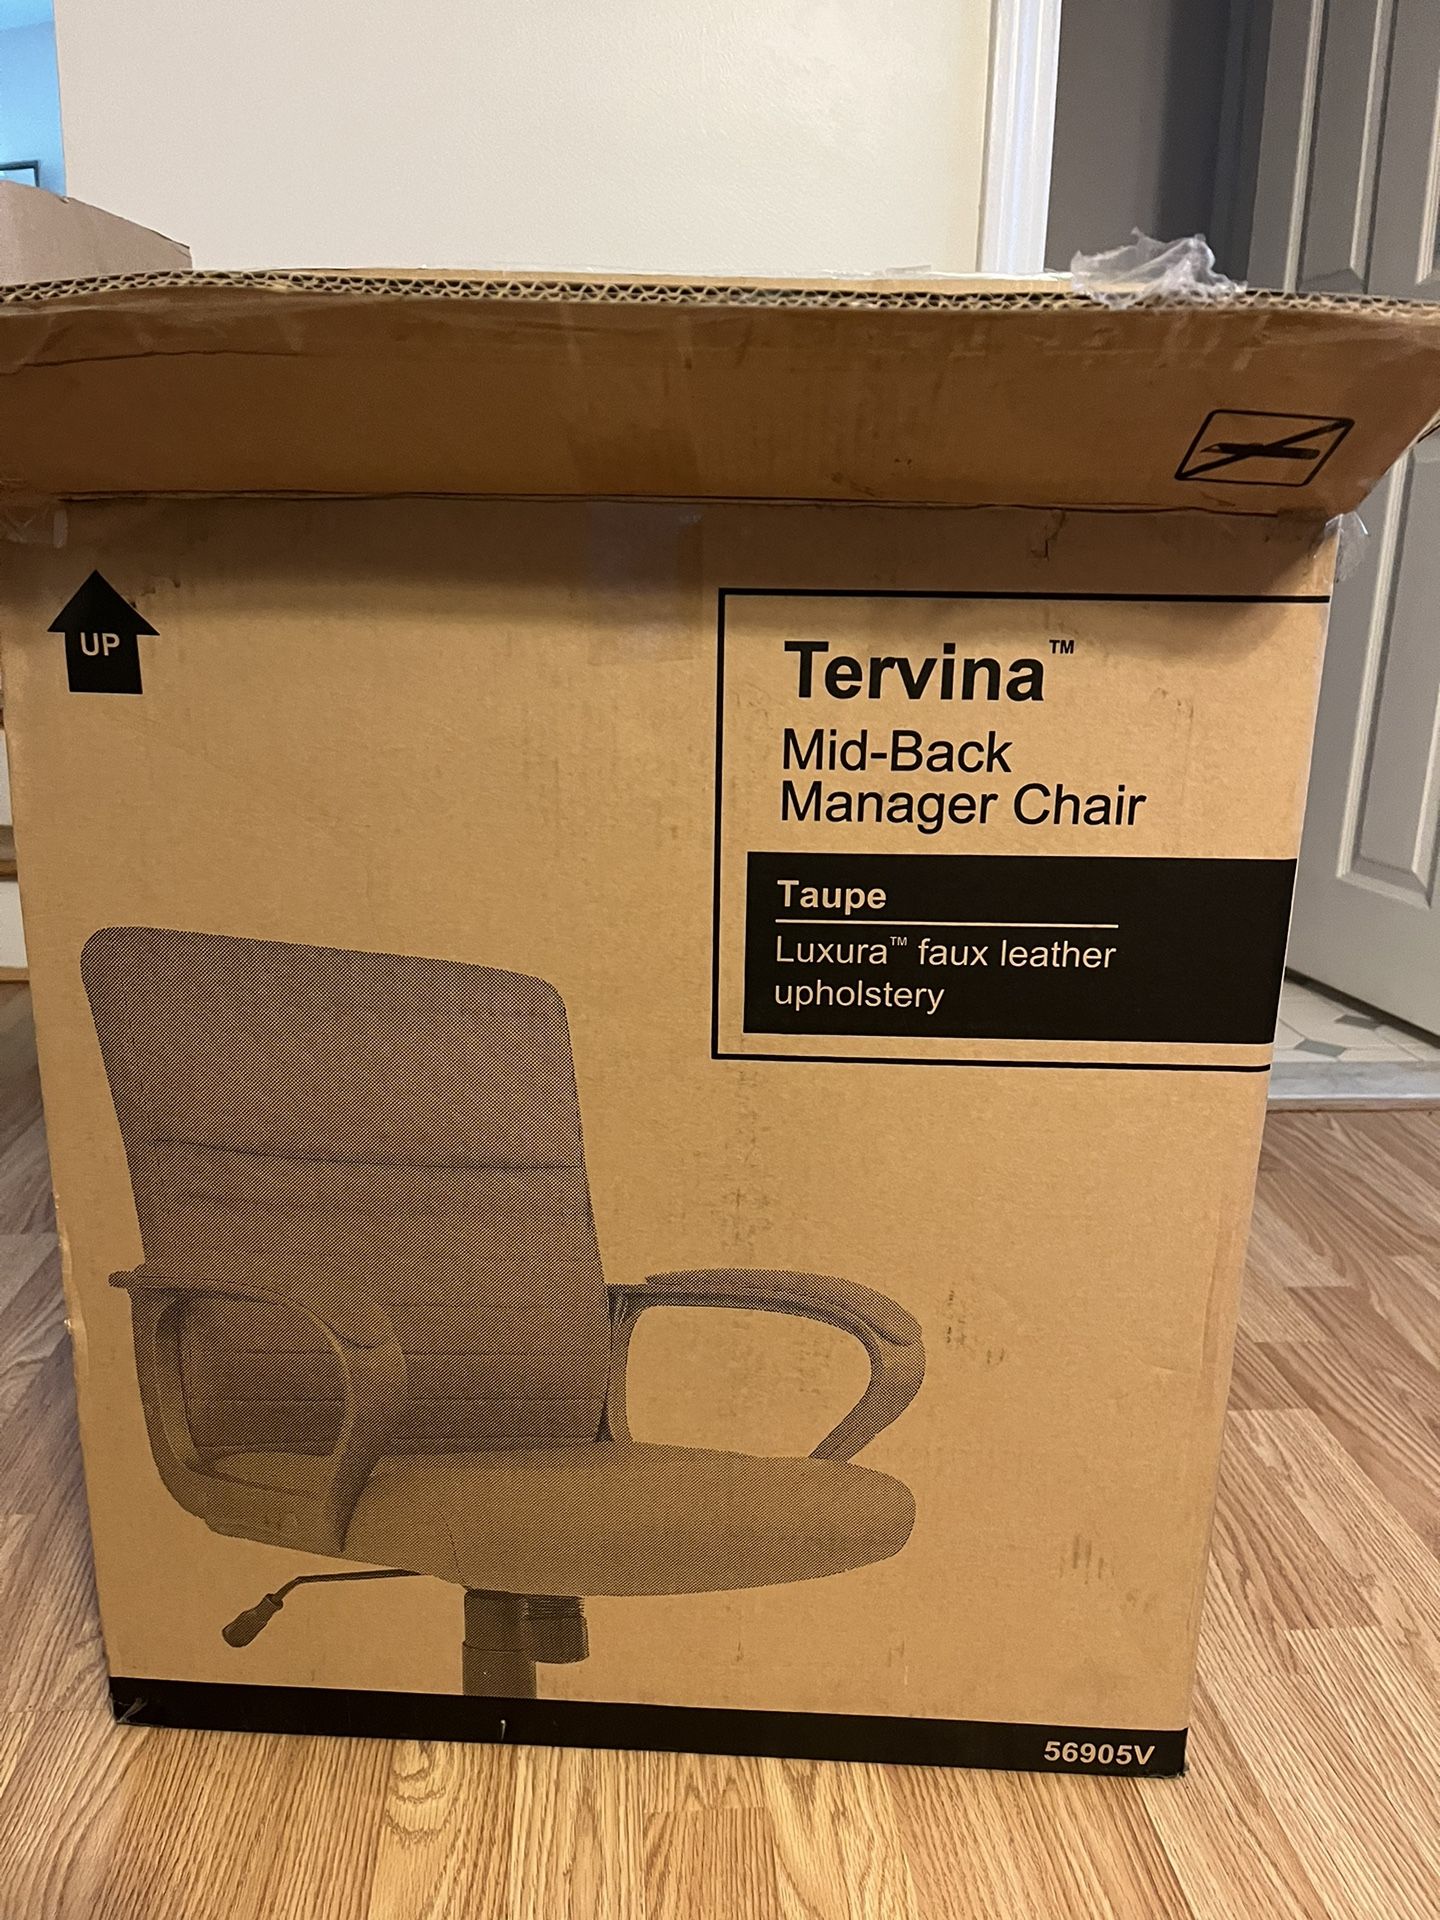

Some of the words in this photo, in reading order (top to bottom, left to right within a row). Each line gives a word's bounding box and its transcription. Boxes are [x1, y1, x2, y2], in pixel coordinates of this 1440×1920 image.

[80, 632, 120, 656] UP
[781, 728, 1013, 773] Mid-Back
[780, 780, 998, 835] Manager
[1013, 783, 1147, 826] Chair
[777, 880, 887, 915] Taupe
[918, 938, 988, 967] faux
[1000, 940, 1117, 969] leather
[774, 980, 945, 1015] upholstery
[1044, 1741, 1155, 1765] 56905V
